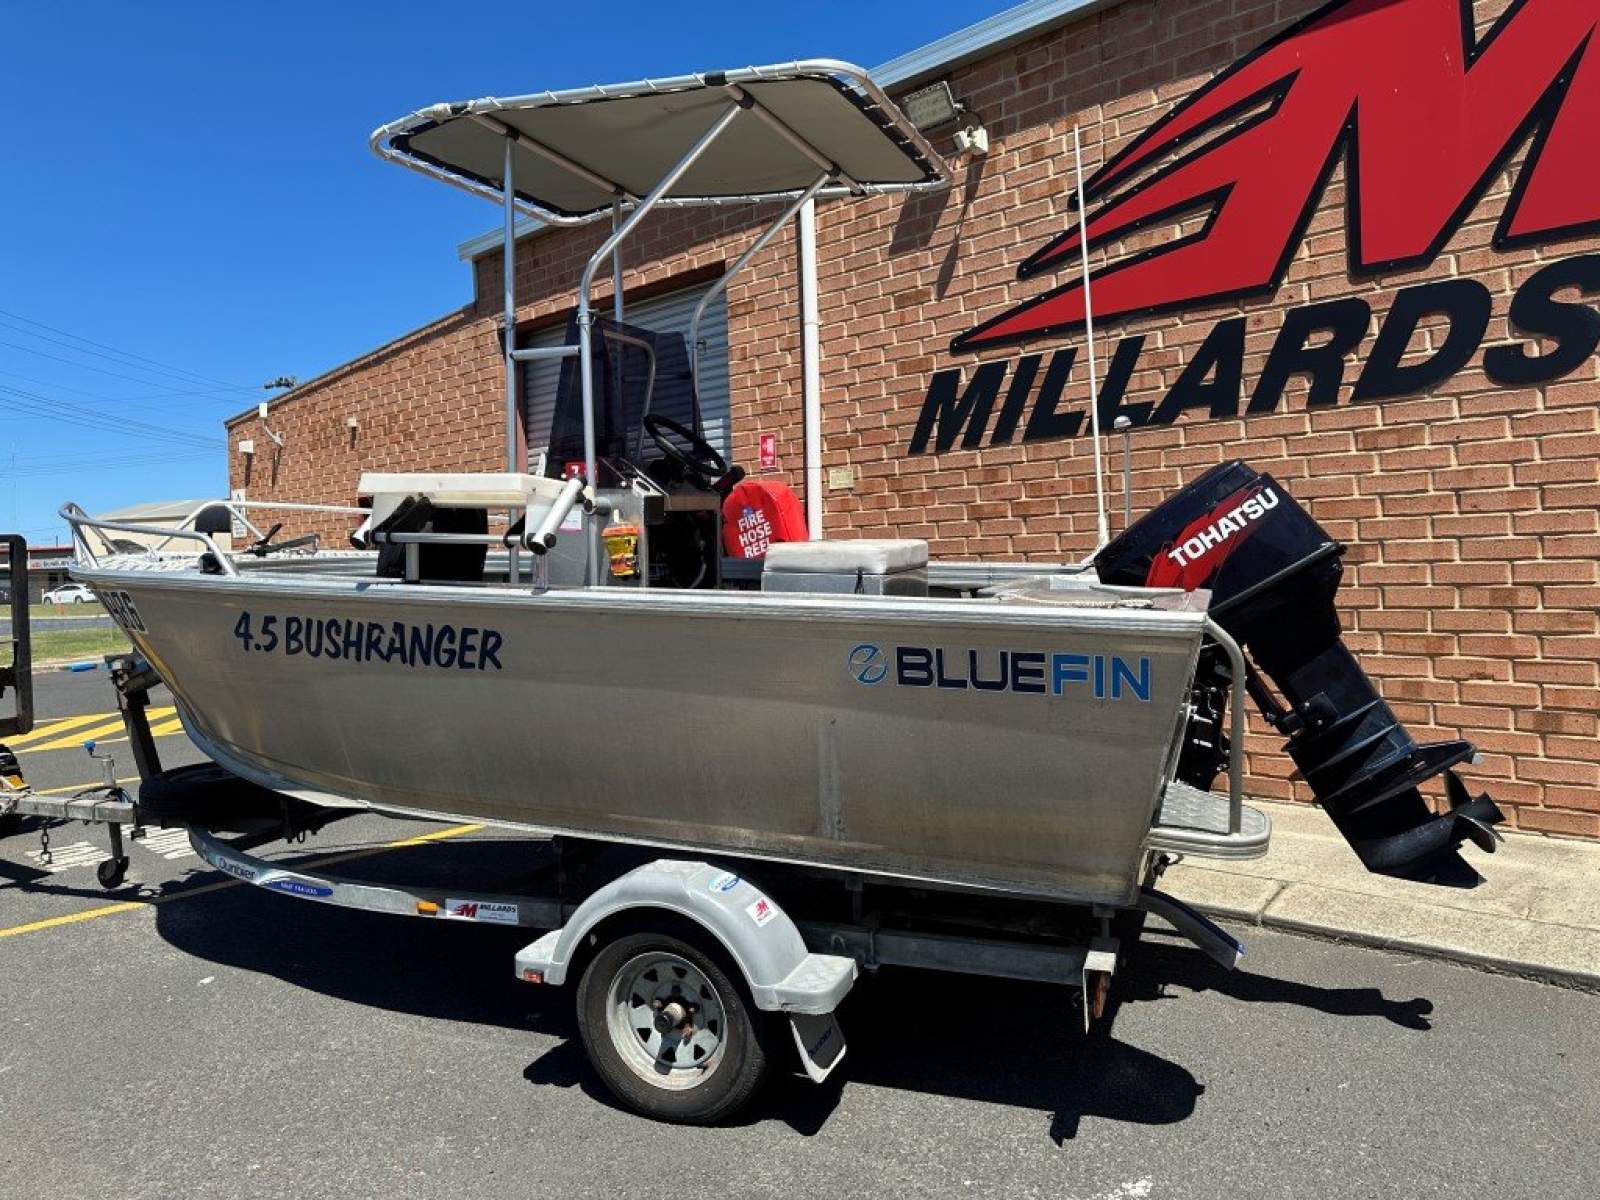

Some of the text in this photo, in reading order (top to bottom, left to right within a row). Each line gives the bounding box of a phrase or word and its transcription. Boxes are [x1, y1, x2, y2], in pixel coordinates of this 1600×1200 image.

[908, 254, 1600, 454] MILLARDS
[738, 509, 766, 532] FIRE
[739, 521, 773, 548] HOSE
[1168, 487, 1279, 567] TOHATSU
[233, 610, 502, 671] 4.5 BUSHRANGER
[896, 646, 1151, 701] BLUEFIN
